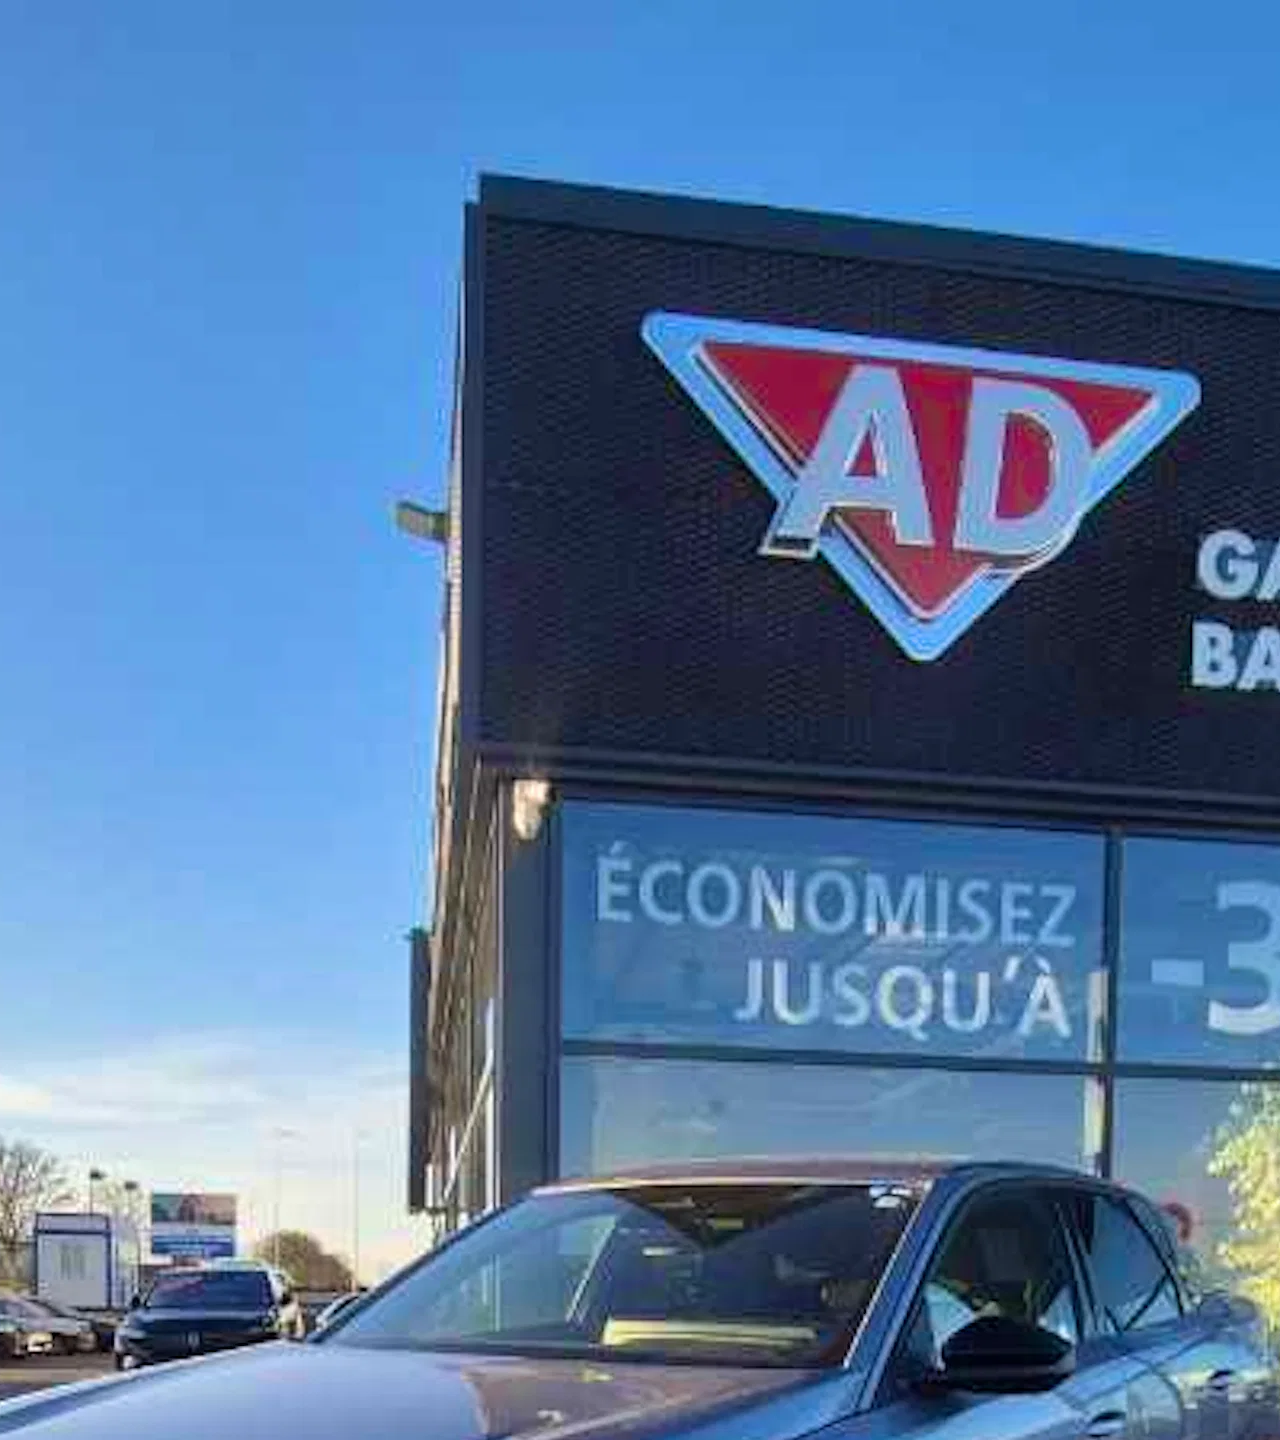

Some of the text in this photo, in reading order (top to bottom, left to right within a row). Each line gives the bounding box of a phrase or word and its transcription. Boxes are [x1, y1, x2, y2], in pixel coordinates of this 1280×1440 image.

[760, 363, 1094, 573] AD
[595, 840, 1077, 948] ÉCONOMISEZ
[734, 955, 1073, 1041] JUSQU'À
